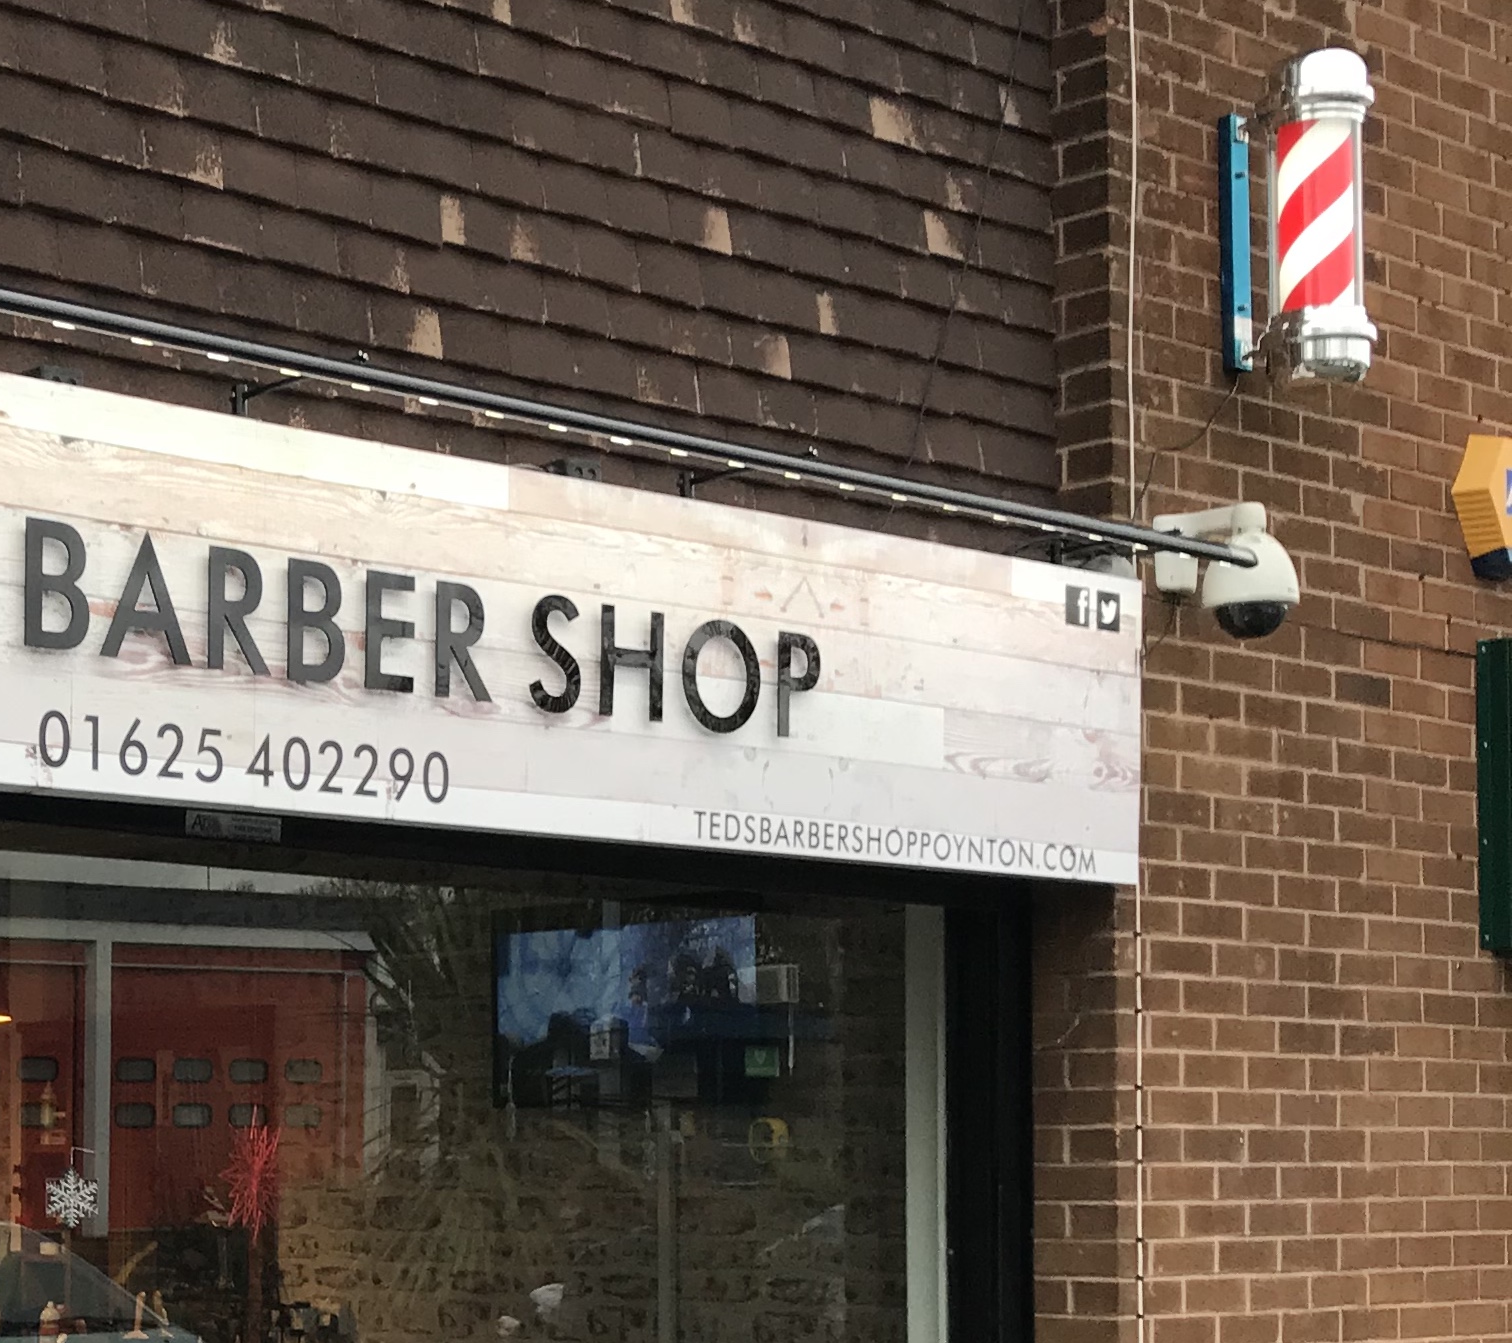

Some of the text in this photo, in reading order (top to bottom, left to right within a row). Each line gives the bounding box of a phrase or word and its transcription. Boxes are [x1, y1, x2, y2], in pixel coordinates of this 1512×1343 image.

[24, 516, 492, 703] BARBER
[528, 594, 821, 737] SHOP
[39, 710, 449, 803] 01625 402290
[693, 811, 1097, 874] TEDSBARBERSHOPPOYNTON.COM
